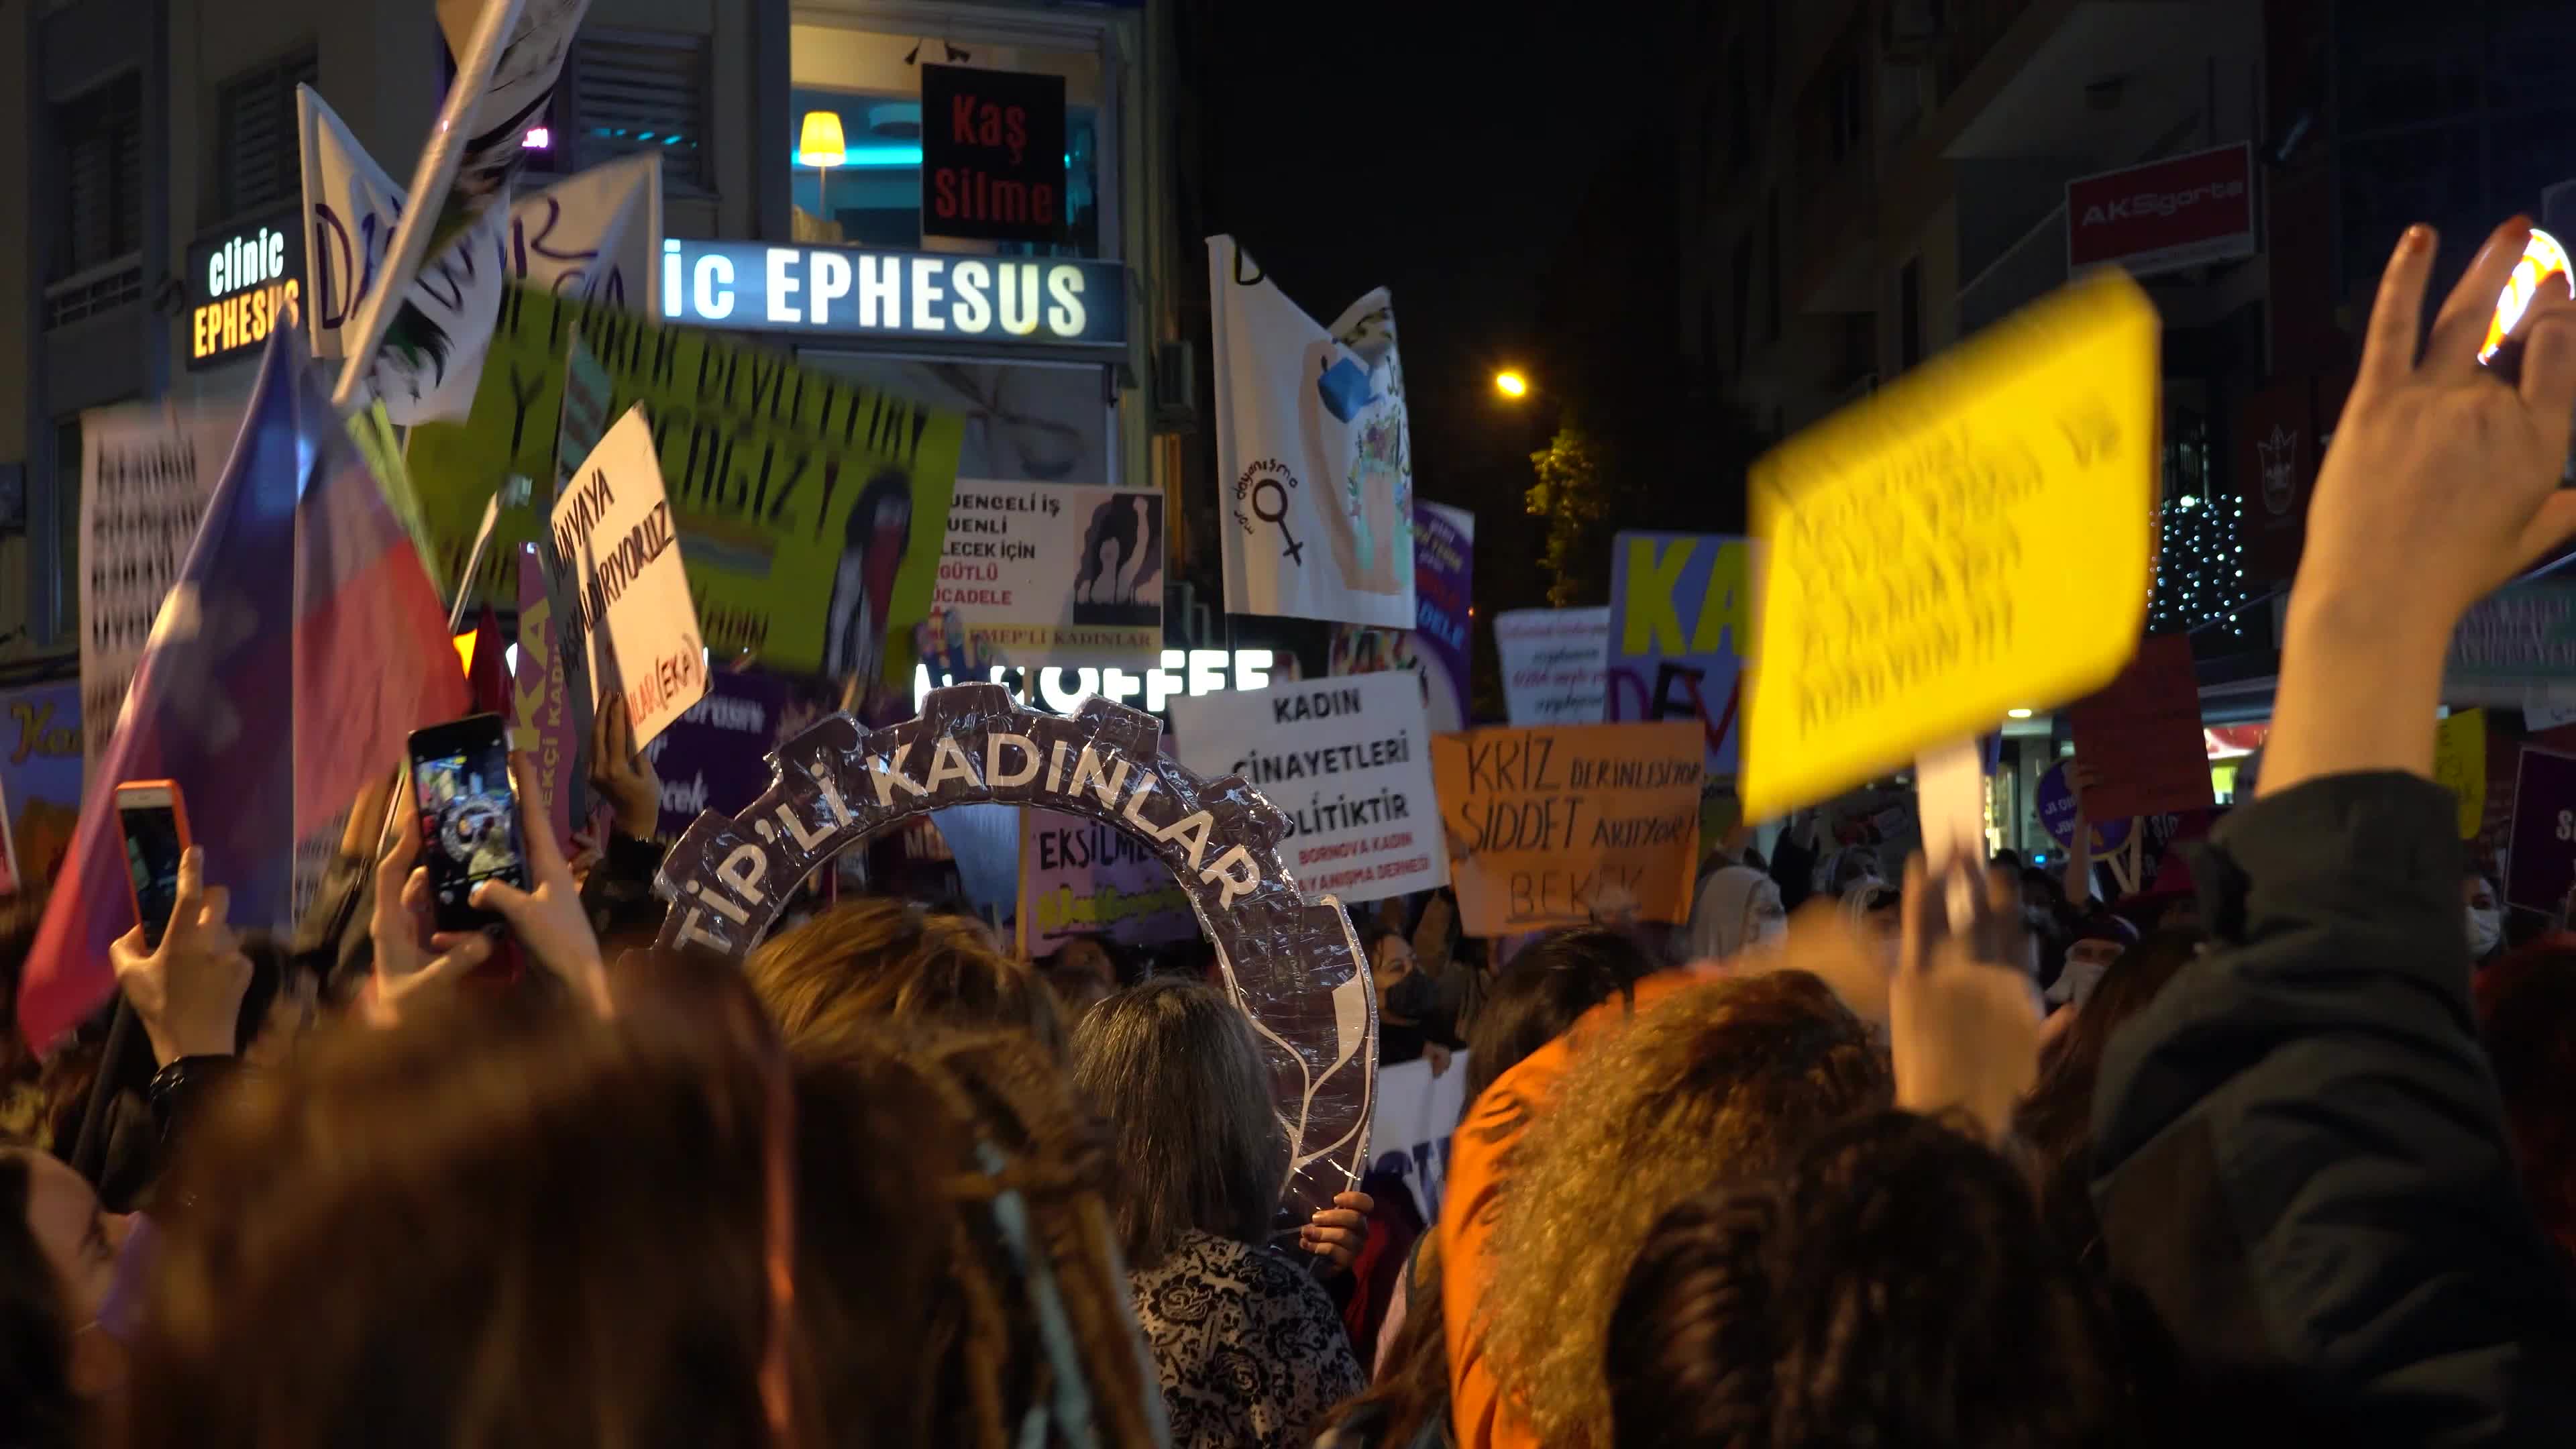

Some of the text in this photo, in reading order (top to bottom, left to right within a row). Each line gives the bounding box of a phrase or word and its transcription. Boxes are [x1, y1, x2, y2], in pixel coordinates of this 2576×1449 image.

[951, 93, 1028, 165] Kaş
[934, 166, 1053, 225] Silme
[209, 227, 284, 297] clinic
[766, 248, 1087, 337] EPHESUS
[940, 562, 999, 581] GÜTLÜ
[942, 541, 996, 558] LECEK
[934, 584, 1013, 606] ÜCADELE
[1622, 537, 1754, 656] KA
[1273, 688, 1361, 723] KADIN
[541, 737, 559, 808] EKÇİ
[865, 733, 1263, 912] KADINLAR
[1287, 787, 1410, 839] OLİTİKTİR
[1298, 870, 1375, 894] AYANIŞMA
